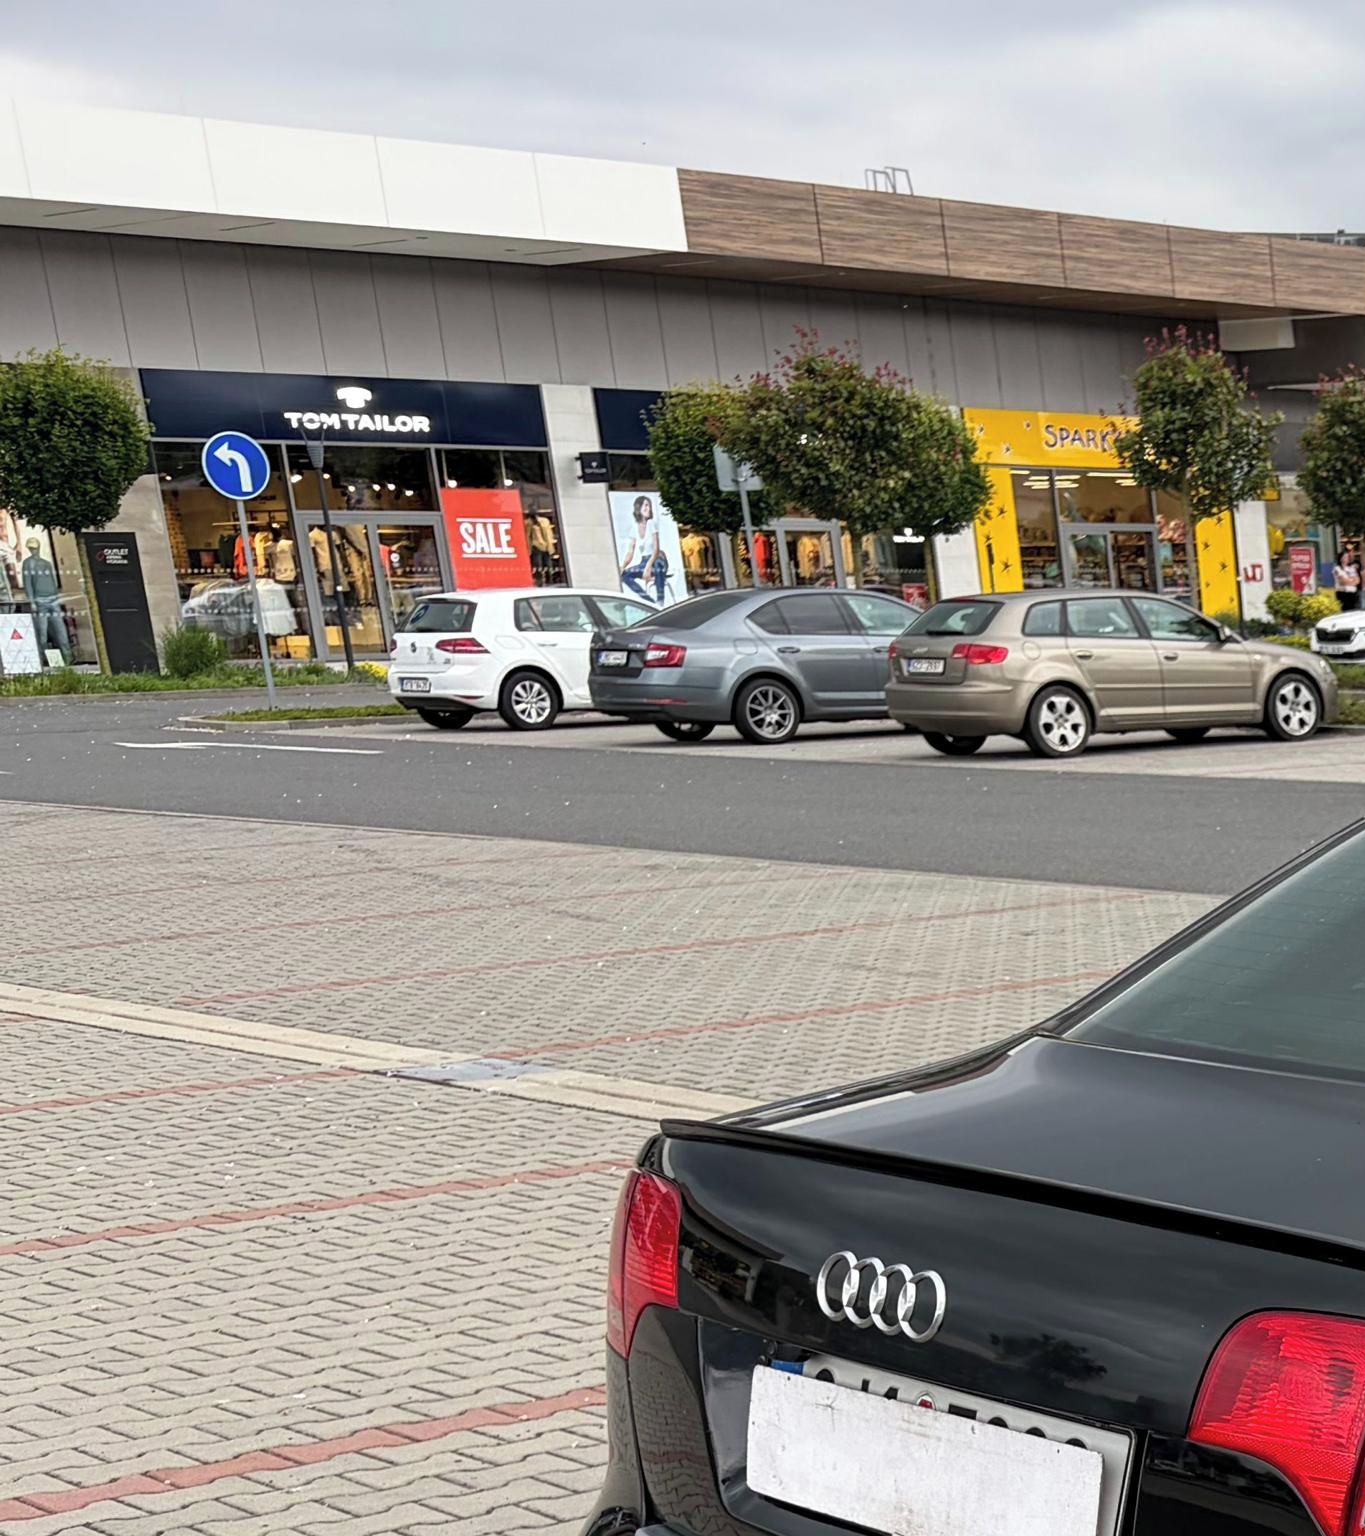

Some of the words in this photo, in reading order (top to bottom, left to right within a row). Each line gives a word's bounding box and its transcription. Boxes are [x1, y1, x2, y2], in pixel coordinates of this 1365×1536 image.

[284, 411, 341, 430] TOM
[341, 413, 431, 433] TAILOR
[1044, 424, 1121, 453] SPARK
[459, 522, 515, 554] SALE
